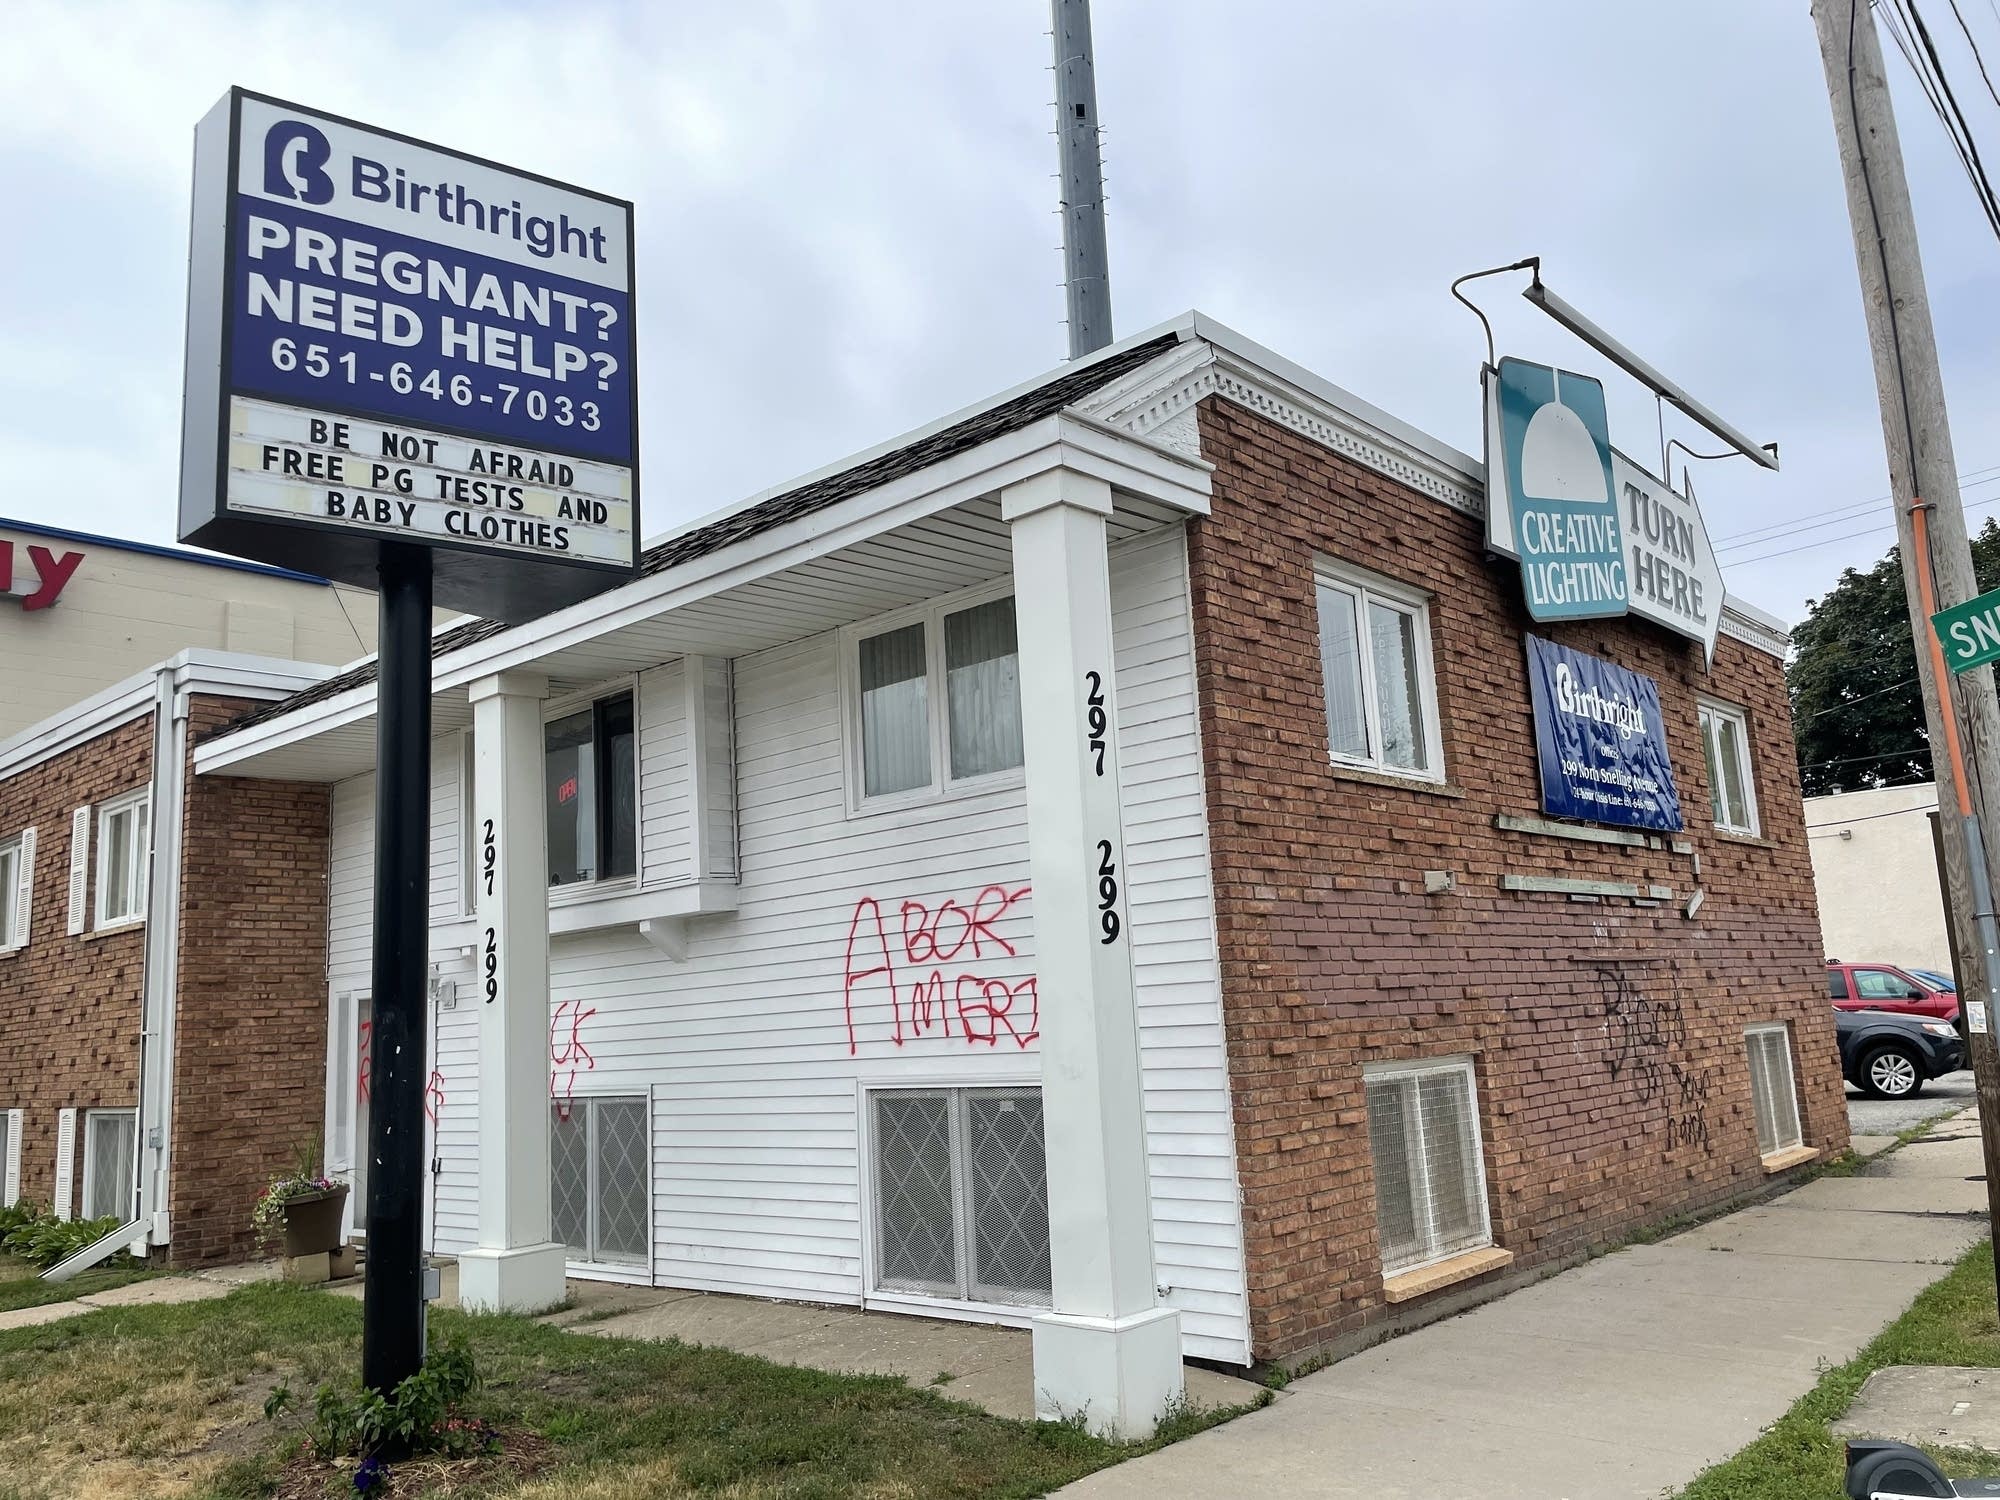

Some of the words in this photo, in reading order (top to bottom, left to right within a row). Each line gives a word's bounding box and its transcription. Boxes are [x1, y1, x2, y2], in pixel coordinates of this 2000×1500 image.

[352, 155, 608, 264] Birthright
[247, 215, 618, 341] PREGNANT?
[247, 272, 424, 348] NEED
[441, 316, 618, 391] HELP?
[271, 337, 602, 432] 651-646-7033
[262, 445, 344, 482] FREE
[371, 464, 414, 494] PG
[436, 474, 524, 511] TESTS
[558, 496, 608, 525] AND
[310, 418, 350, 449] BE
[381, 431, 439, 464] NOT
[469, 448, 574, 487] AFRAID
[327, 491, 416, 526] BABY
[445, 511, 569, 550] CLOTHES
[1522, 510, 1618, 554] CREATIVE
[1624, 481, 1696, 568] TURN
[1528, 560, 1625, 605] LIGHTING
[1632, 545, 1706, 626] HERE
[1950, 607, 2000, 658] SN
[1086, 671, 1106, 777] 297
[1556, 663, 1646, 739] Birthright
[559, 777, 577, 803] OPEN
[1562, 760, 1577, 776] 299
[1578, 763, 1600, 782] North
[1600, 768, 1632, 792] Snelling
[1633, 775, 1658, 794] Avenue
[483, 819, 496, 896] 297
[1097, 839, 1120, 945] 299
[485, 927, 497, 1004] 299
